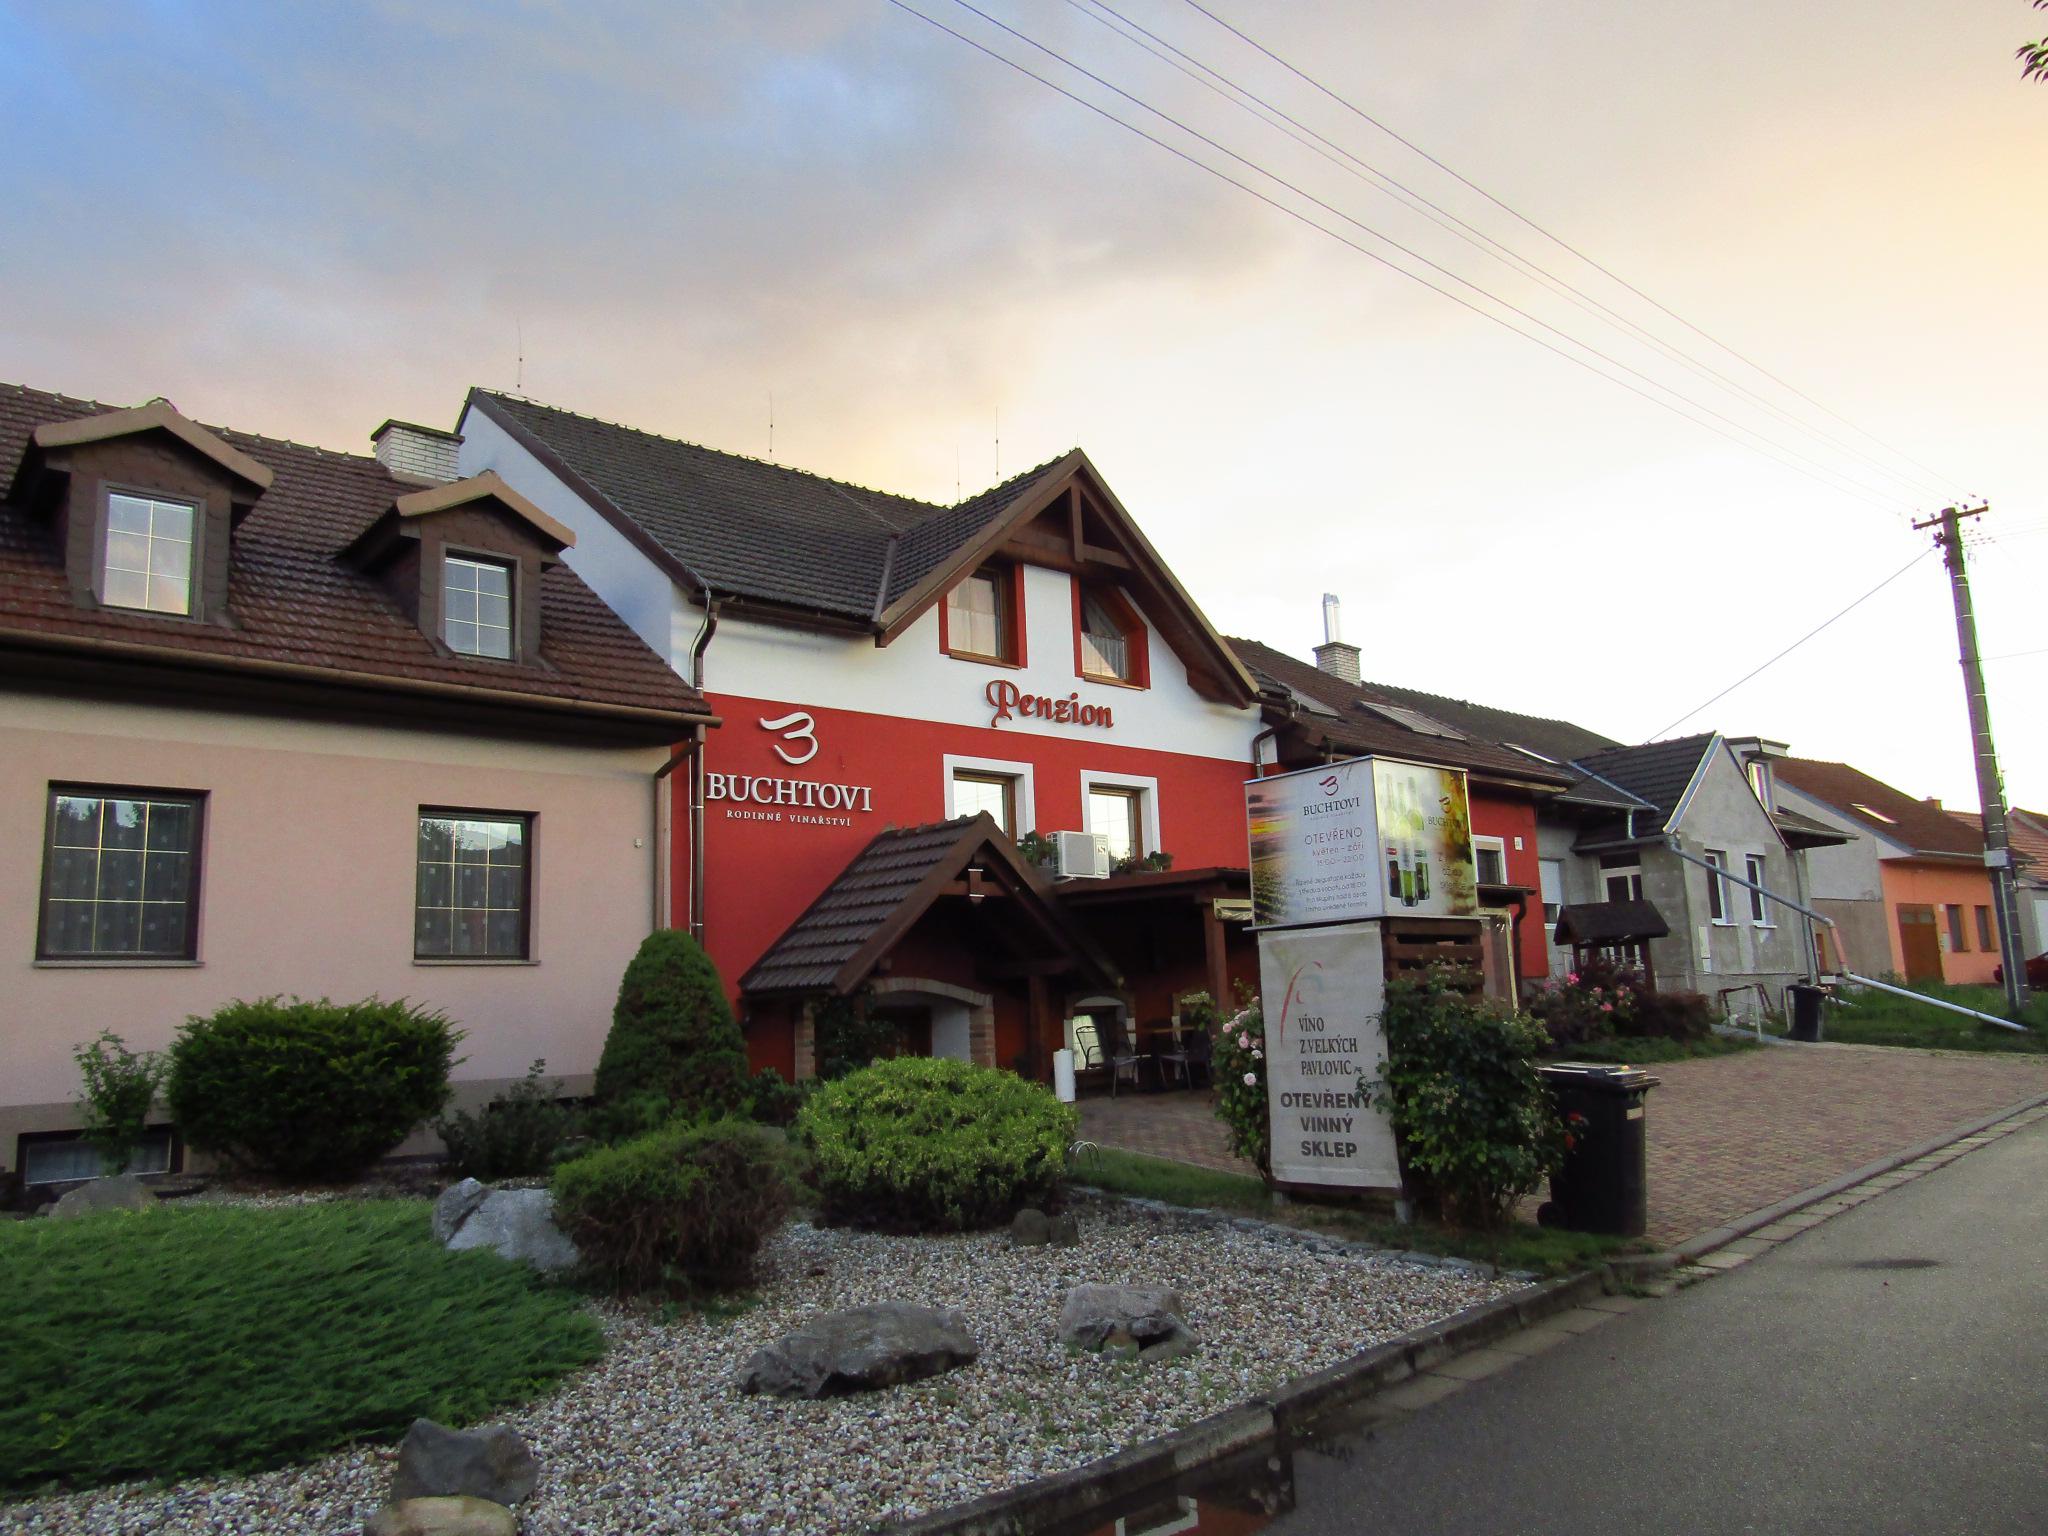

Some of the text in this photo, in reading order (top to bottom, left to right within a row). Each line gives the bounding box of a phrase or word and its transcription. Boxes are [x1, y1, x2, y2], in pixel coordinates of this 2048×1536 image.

[986, 679, 1114, 728] Penzion
[706, 772, 872, 811] BUCHTOVI
[1303, 797, 1361, 816] BUCHTOVI
[727, 809, 851, 827] RODINNÉ VINAŘSTVÍ
[1304, 827, 1363, 845] OTEVŘENO
[1299, 1014, 1325, 1032] VÍNO
[1300, 1034, 1358, 1054] Z VELKÝCH
[1301, 1060, 1352, 1075] PAVLOVIC
[1300, 1113, 1353, 1133] VINNÝ
[1301, 1140, 1358, 1158] SKLEP
